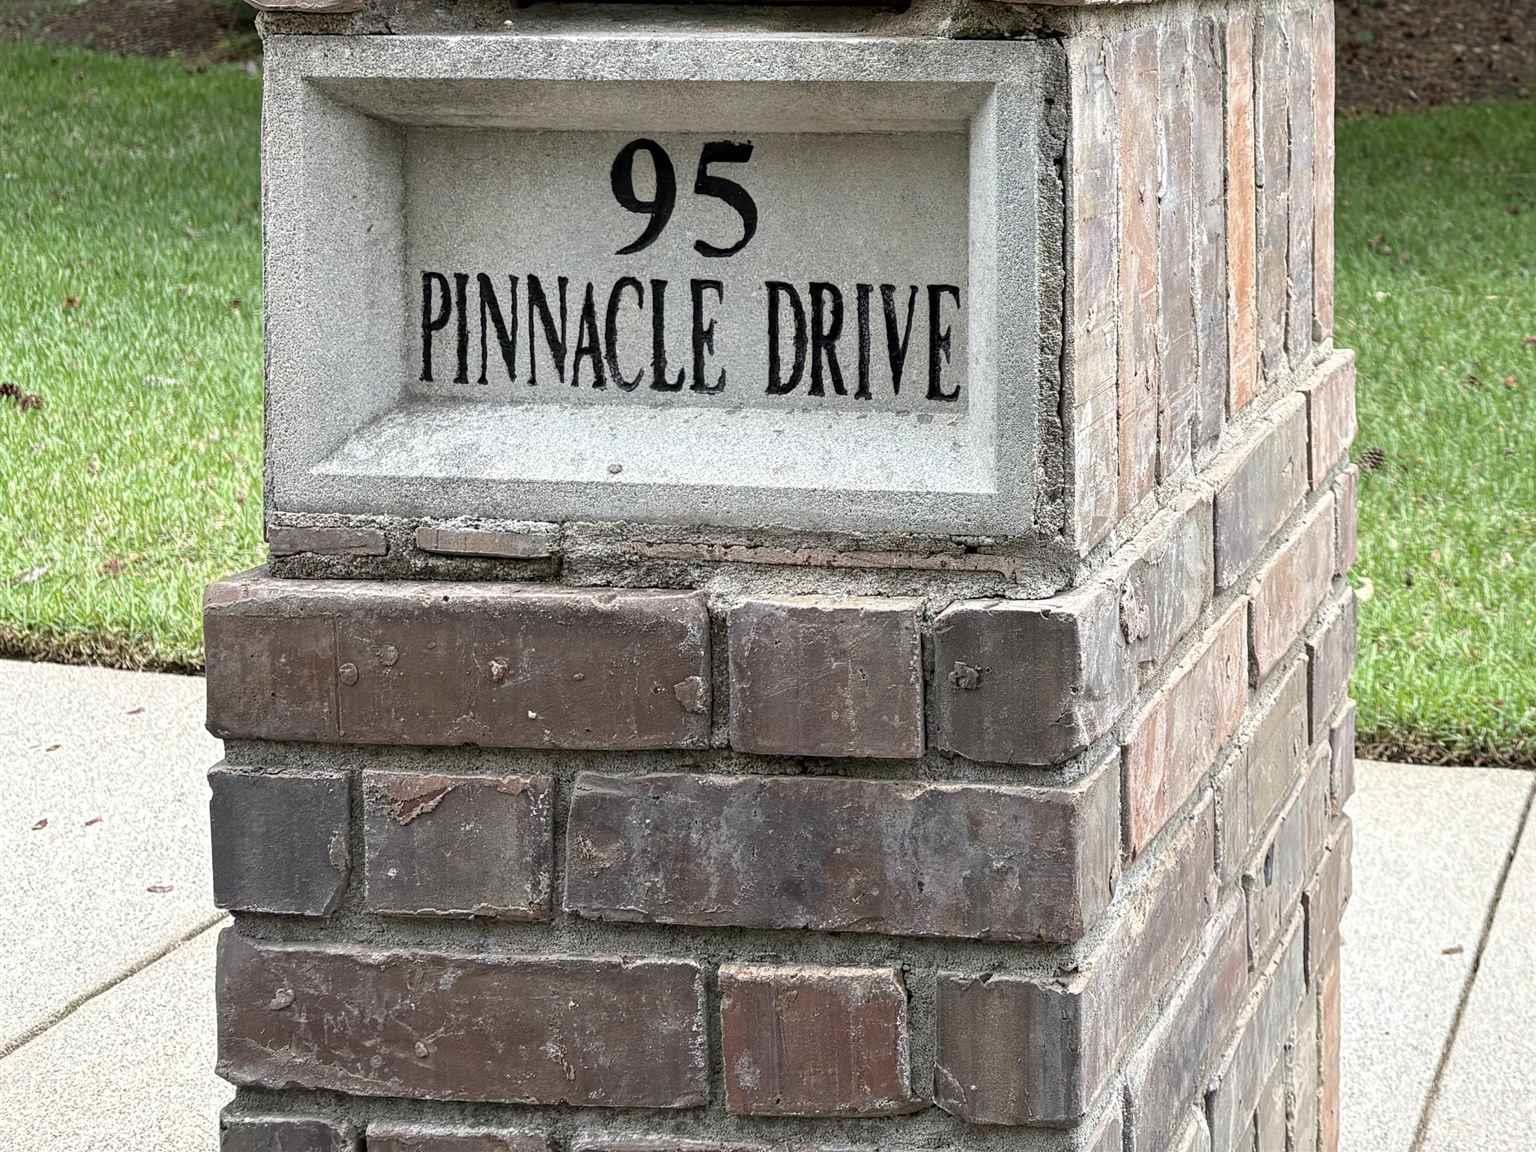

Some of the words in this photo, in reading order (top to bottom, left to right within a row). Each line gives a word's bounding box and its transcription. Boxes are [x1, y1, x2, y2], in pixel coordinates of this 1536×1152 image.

[610, 138, 758, 257] 95
[419, 271, 726, 394] PINNACLE
[766, 280, 961, 402] DRIVE
